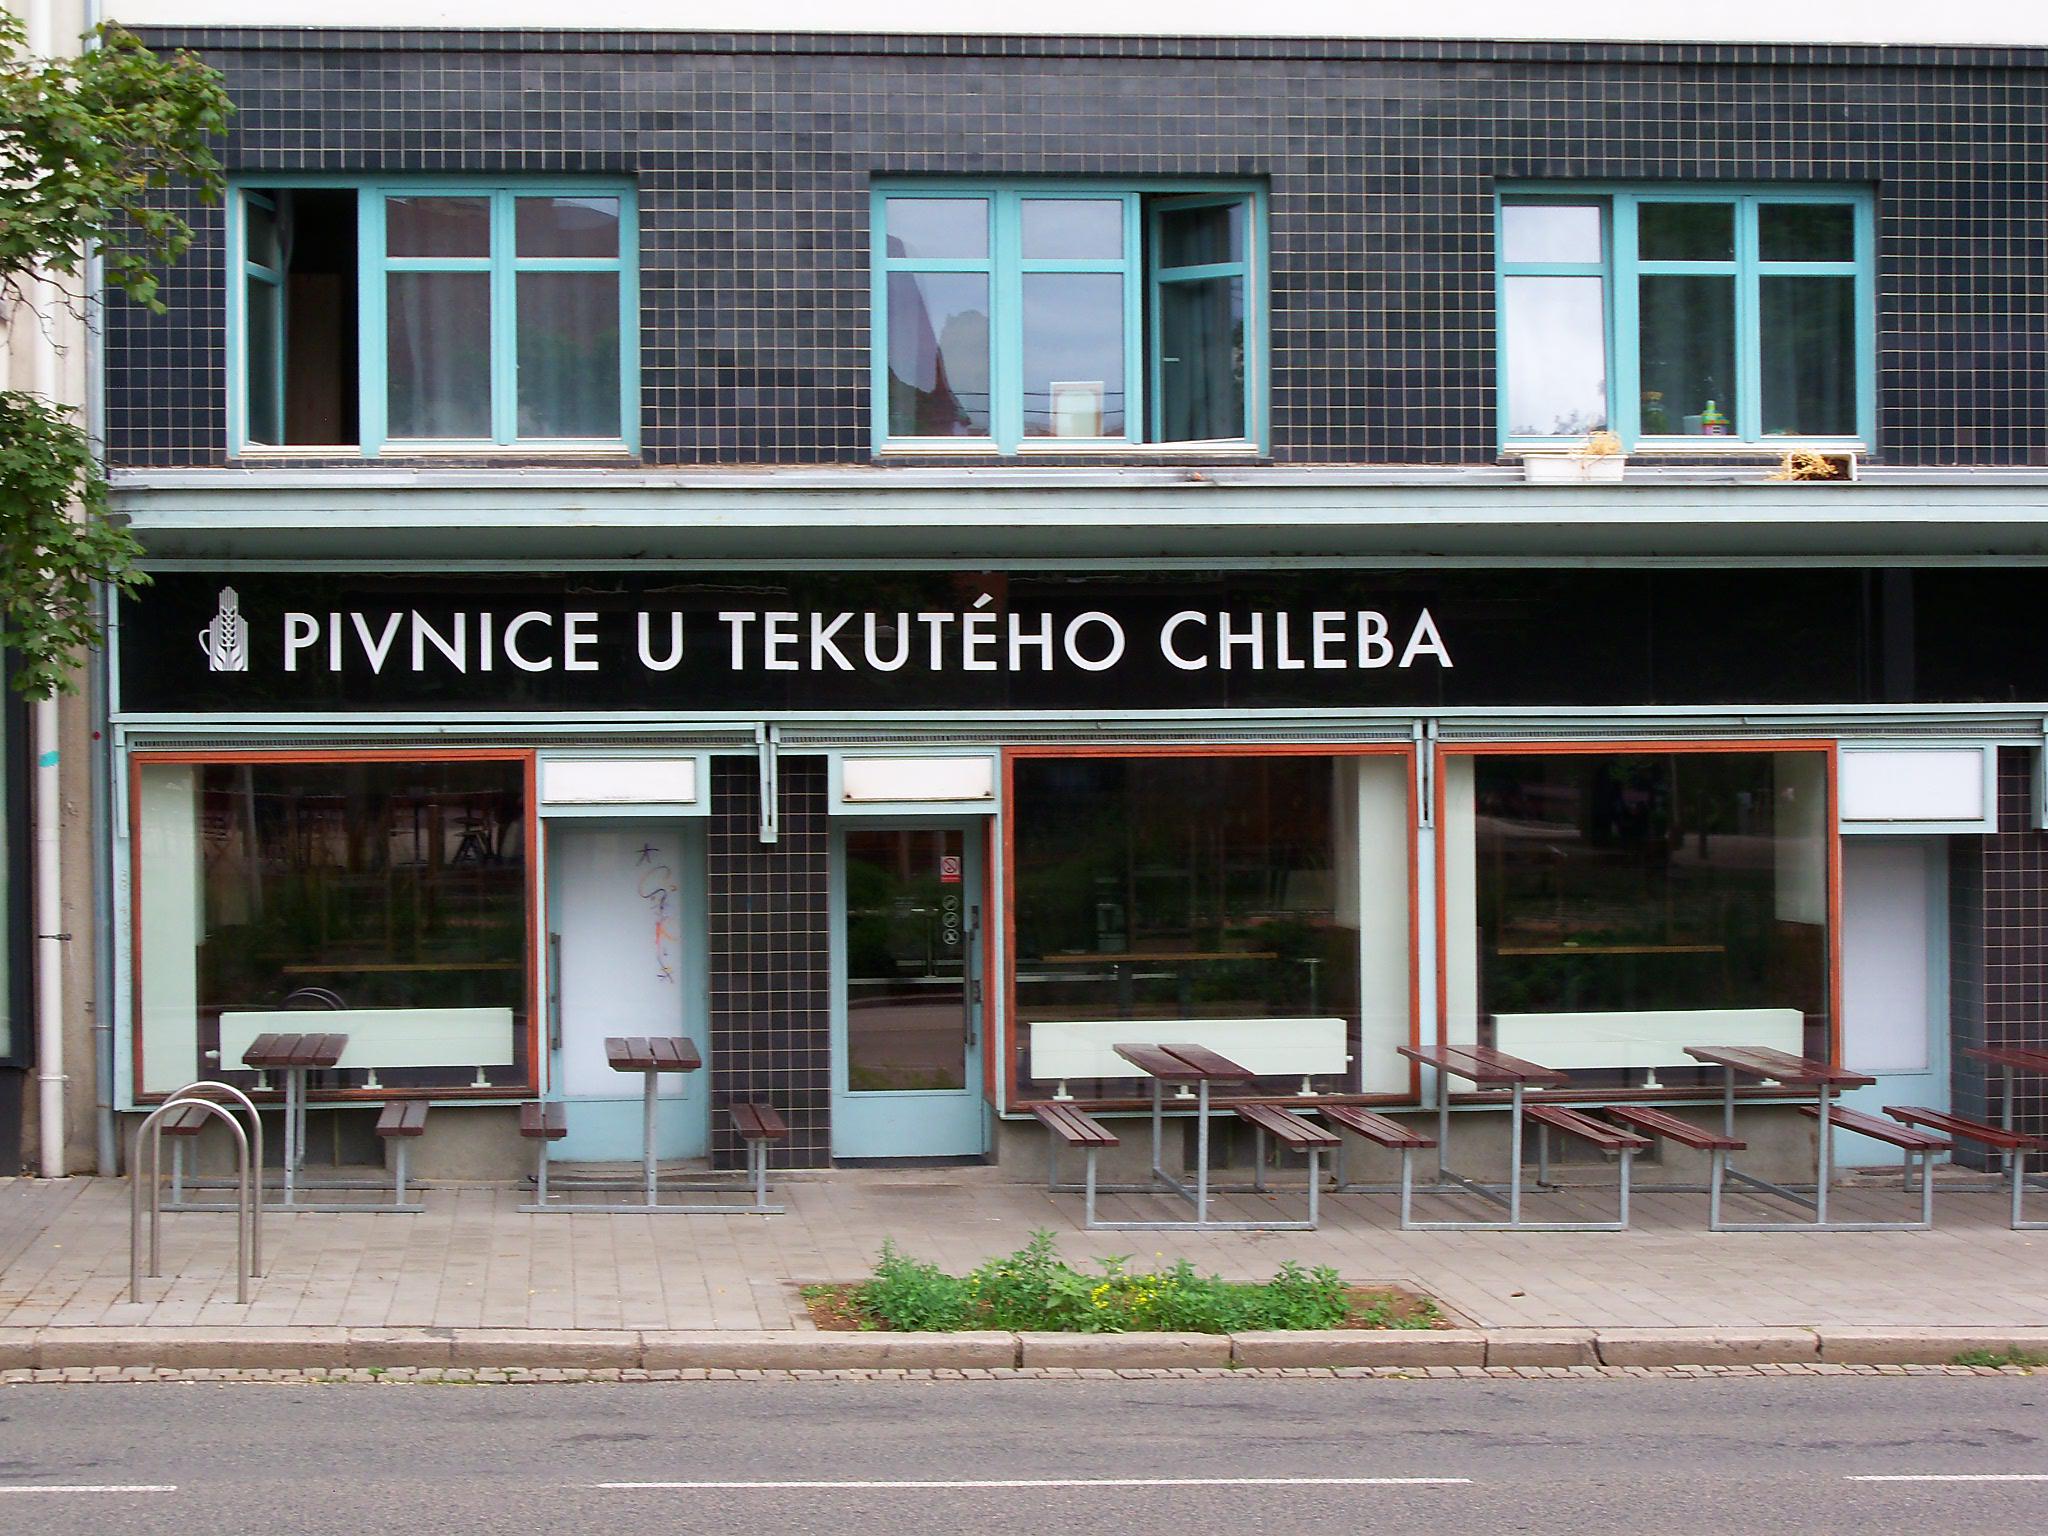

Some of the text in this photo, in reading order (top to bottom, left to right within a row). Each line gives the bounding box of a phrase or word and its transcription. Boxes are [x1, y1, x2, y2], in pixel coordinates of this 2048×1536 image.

[284, 592, 1454, 674] PIVNICE U TEKUTÉHO CHLEBA
